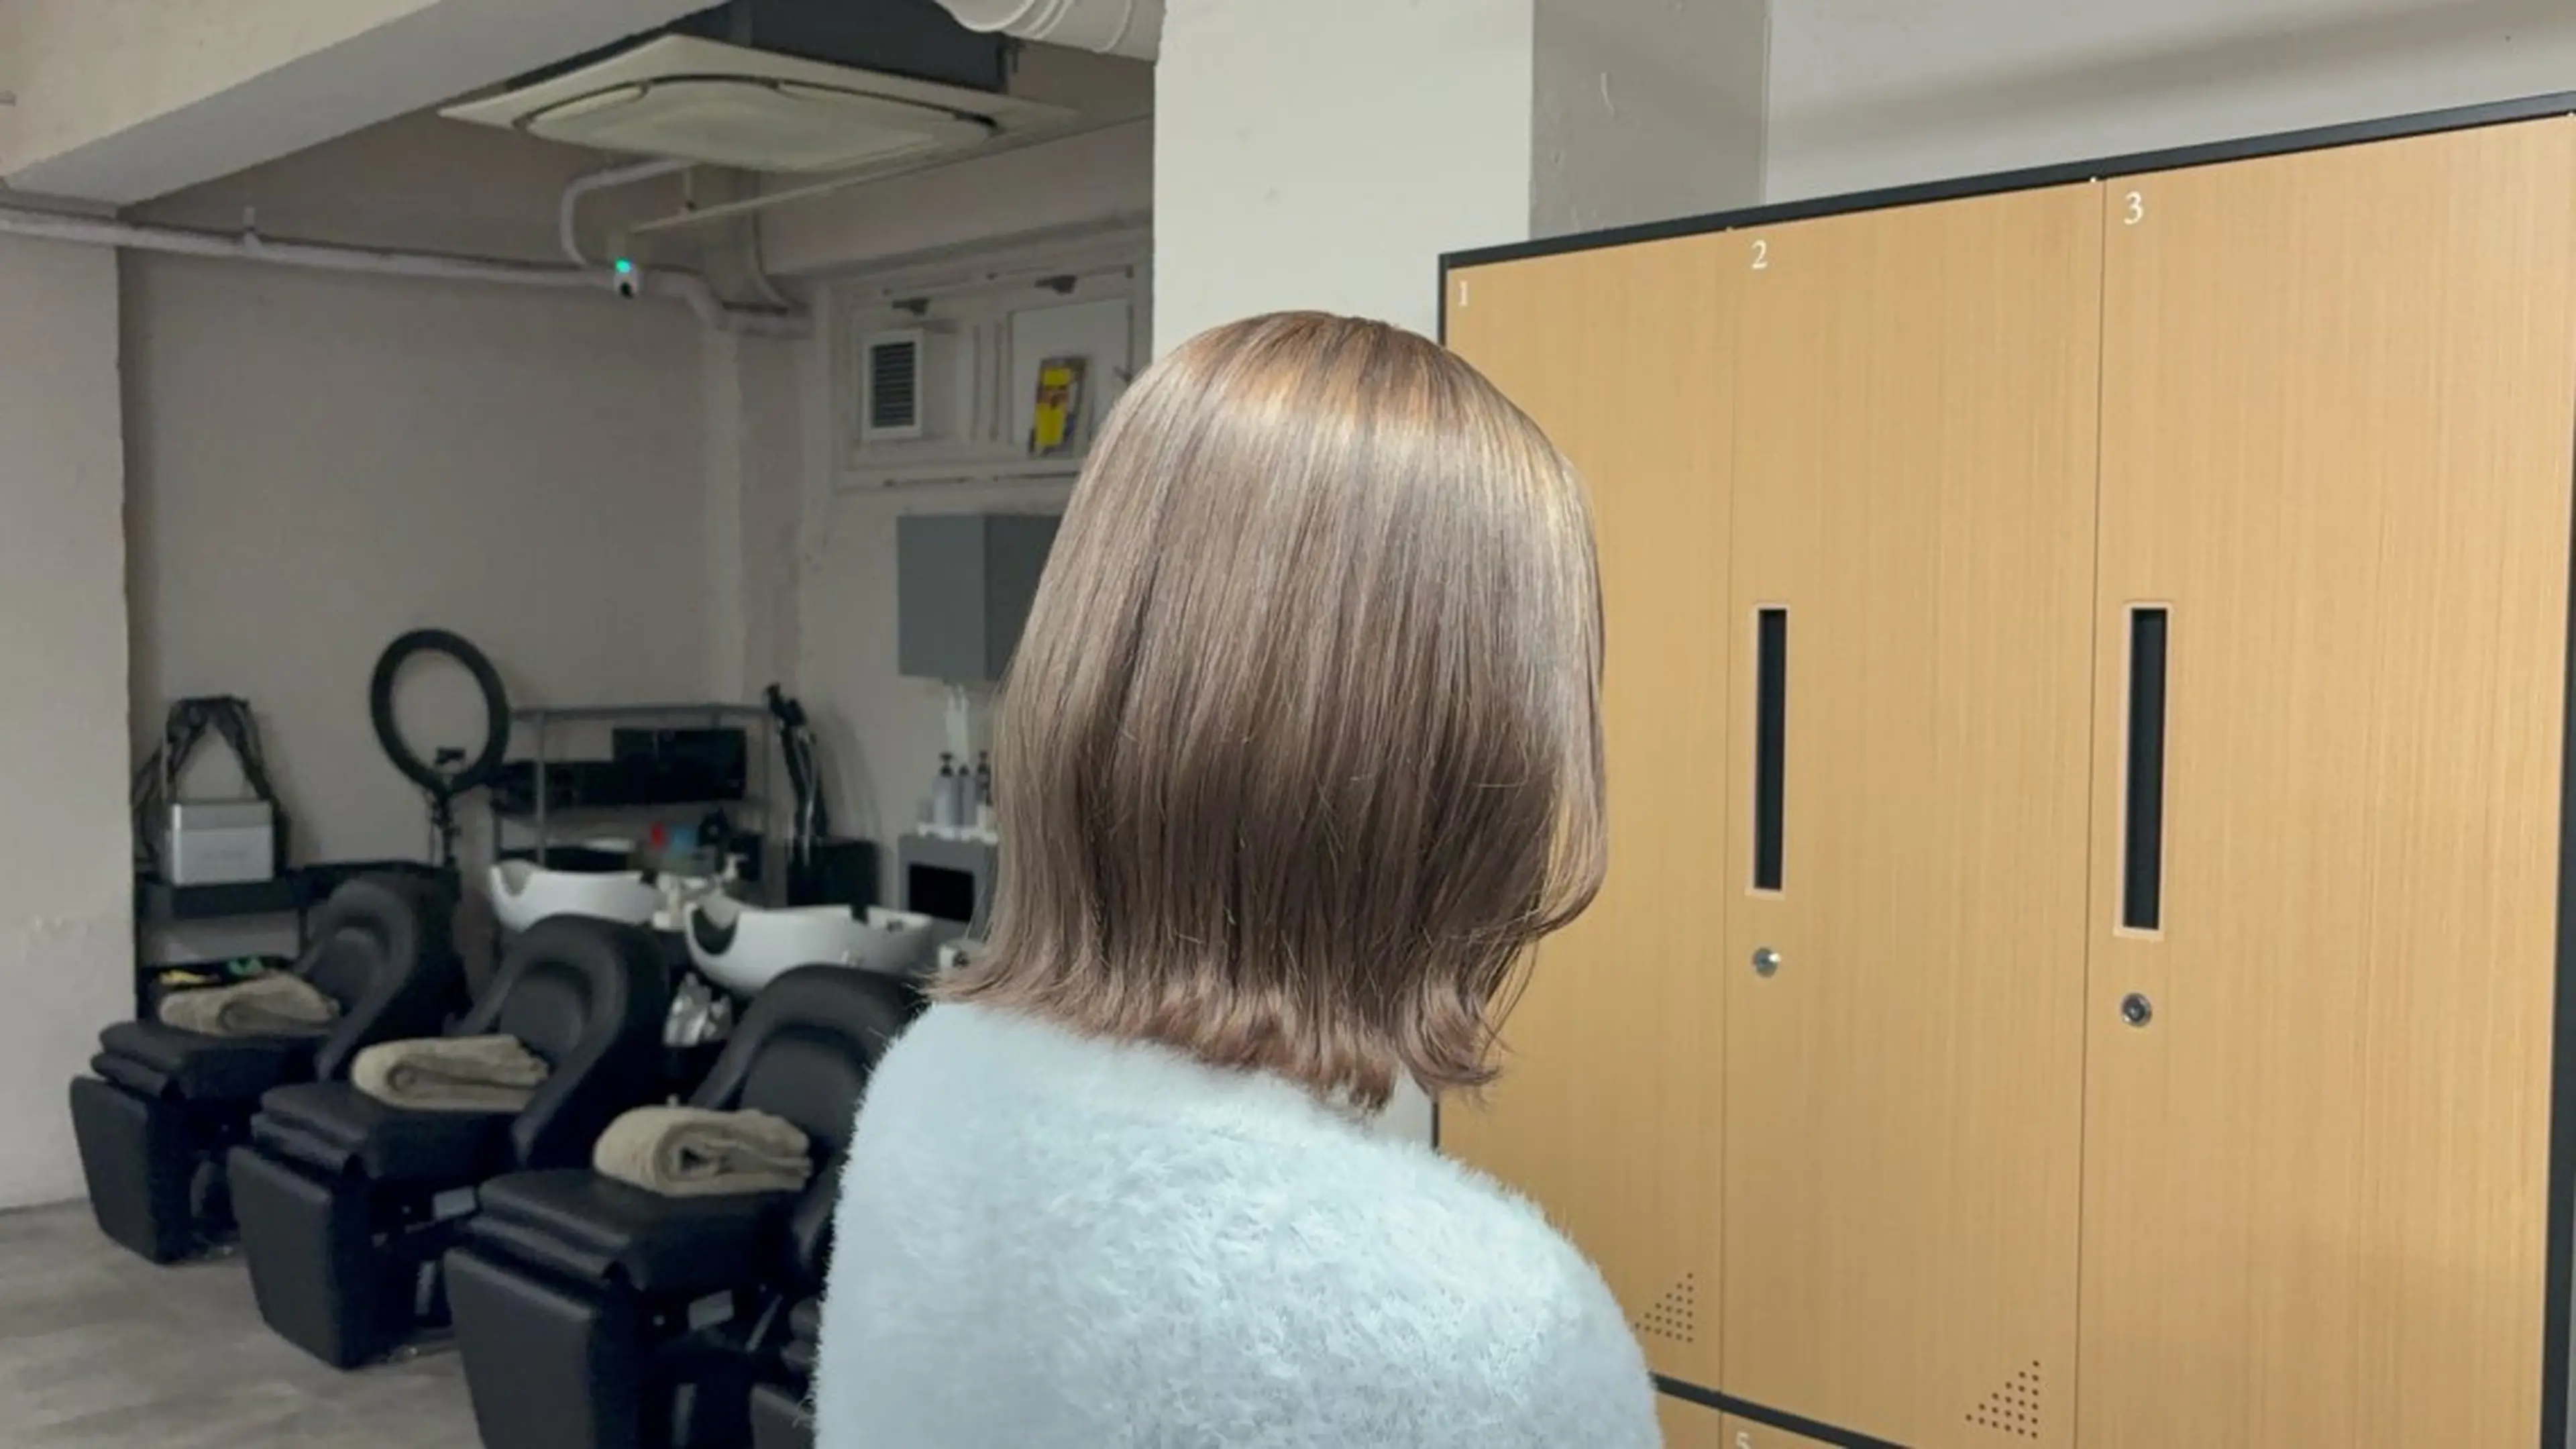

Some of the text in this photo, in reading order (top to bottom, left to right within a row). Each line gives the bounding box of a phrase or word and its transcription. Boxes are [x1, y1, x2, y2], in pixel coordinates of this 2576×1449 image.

[2123, 191, 2144, 225] 3
[1752, 239, 1768, 270] 2
[1458, 280, 1468, 307] 1
